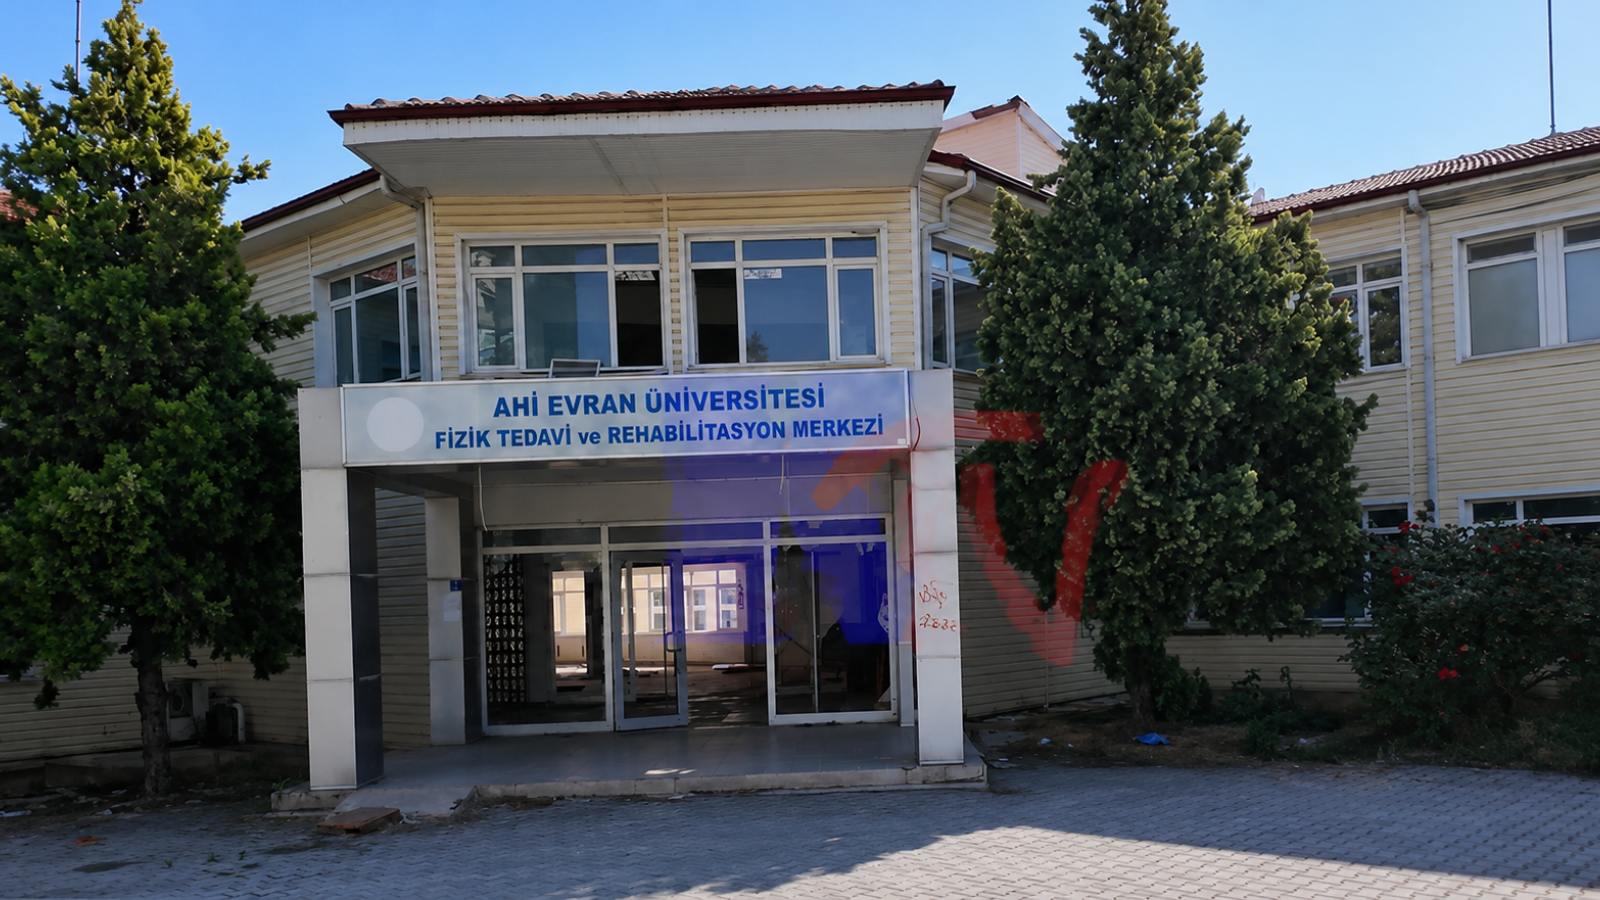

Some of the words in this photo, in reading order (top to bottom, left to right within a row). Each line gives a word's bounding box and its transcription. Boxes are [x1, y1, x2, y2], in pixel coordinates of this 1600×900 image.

[493, 391, 539, 418] AHİ
[547, 393, 636, 416] EVRAN
[645, 382, 825, 414] ÜNİVERSİTESİ
[435, 426, 491, 449] FİZİK
[496, 423, 572, 448] TEDAVİ
[577, 431, 601, 445] ve
[607, 418, 786, 445] REHABİLİTASYON
[792, 413, 884, 439] MERKEZİ
